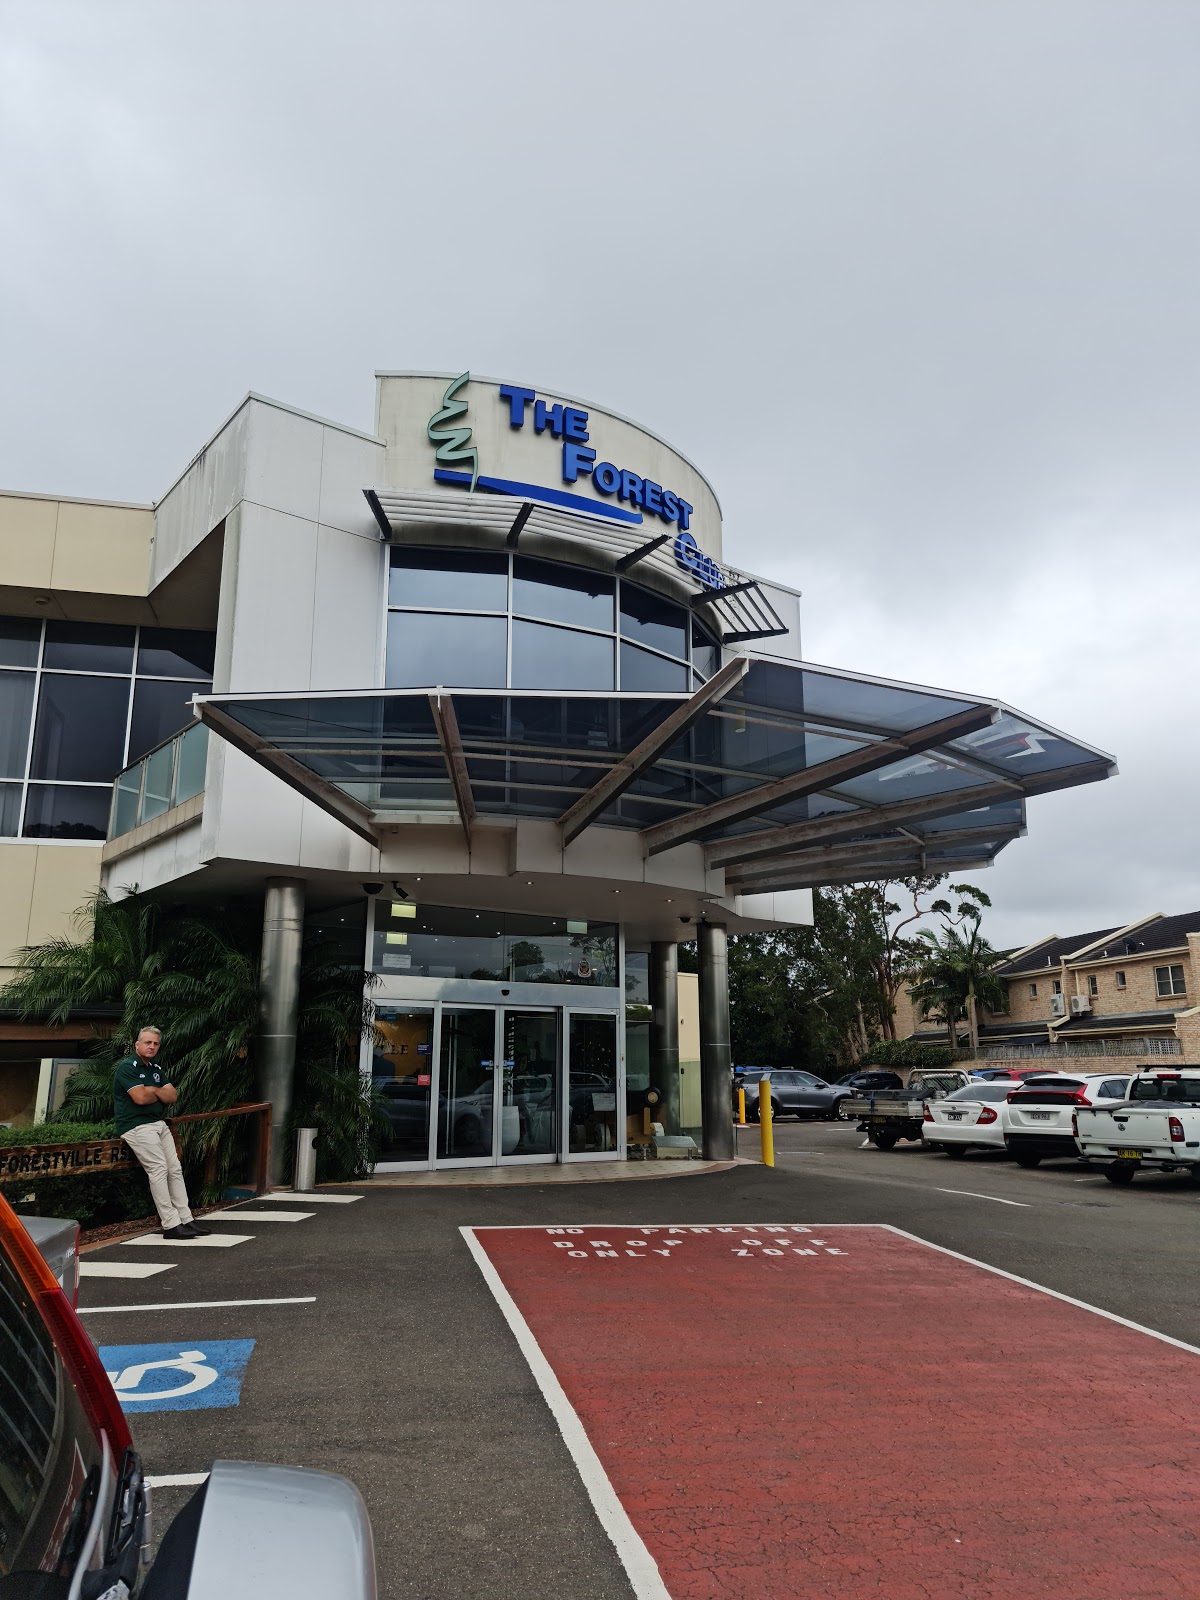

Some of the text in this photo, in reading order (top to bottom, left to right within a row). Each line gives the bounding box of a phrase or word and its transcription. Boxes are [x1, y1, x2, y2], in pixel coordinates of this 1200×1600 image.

[500, 384, 589, 443] THE
[562, 441, 694, 531] FOREST
[0, 1147, 103, 1174] FORESTVILLE
[640, 1226, 813, 1235] PARKING
[552, 1239, 684, 1248] DROP
[567, 1248, 850, 1258] ONLY ZONE
